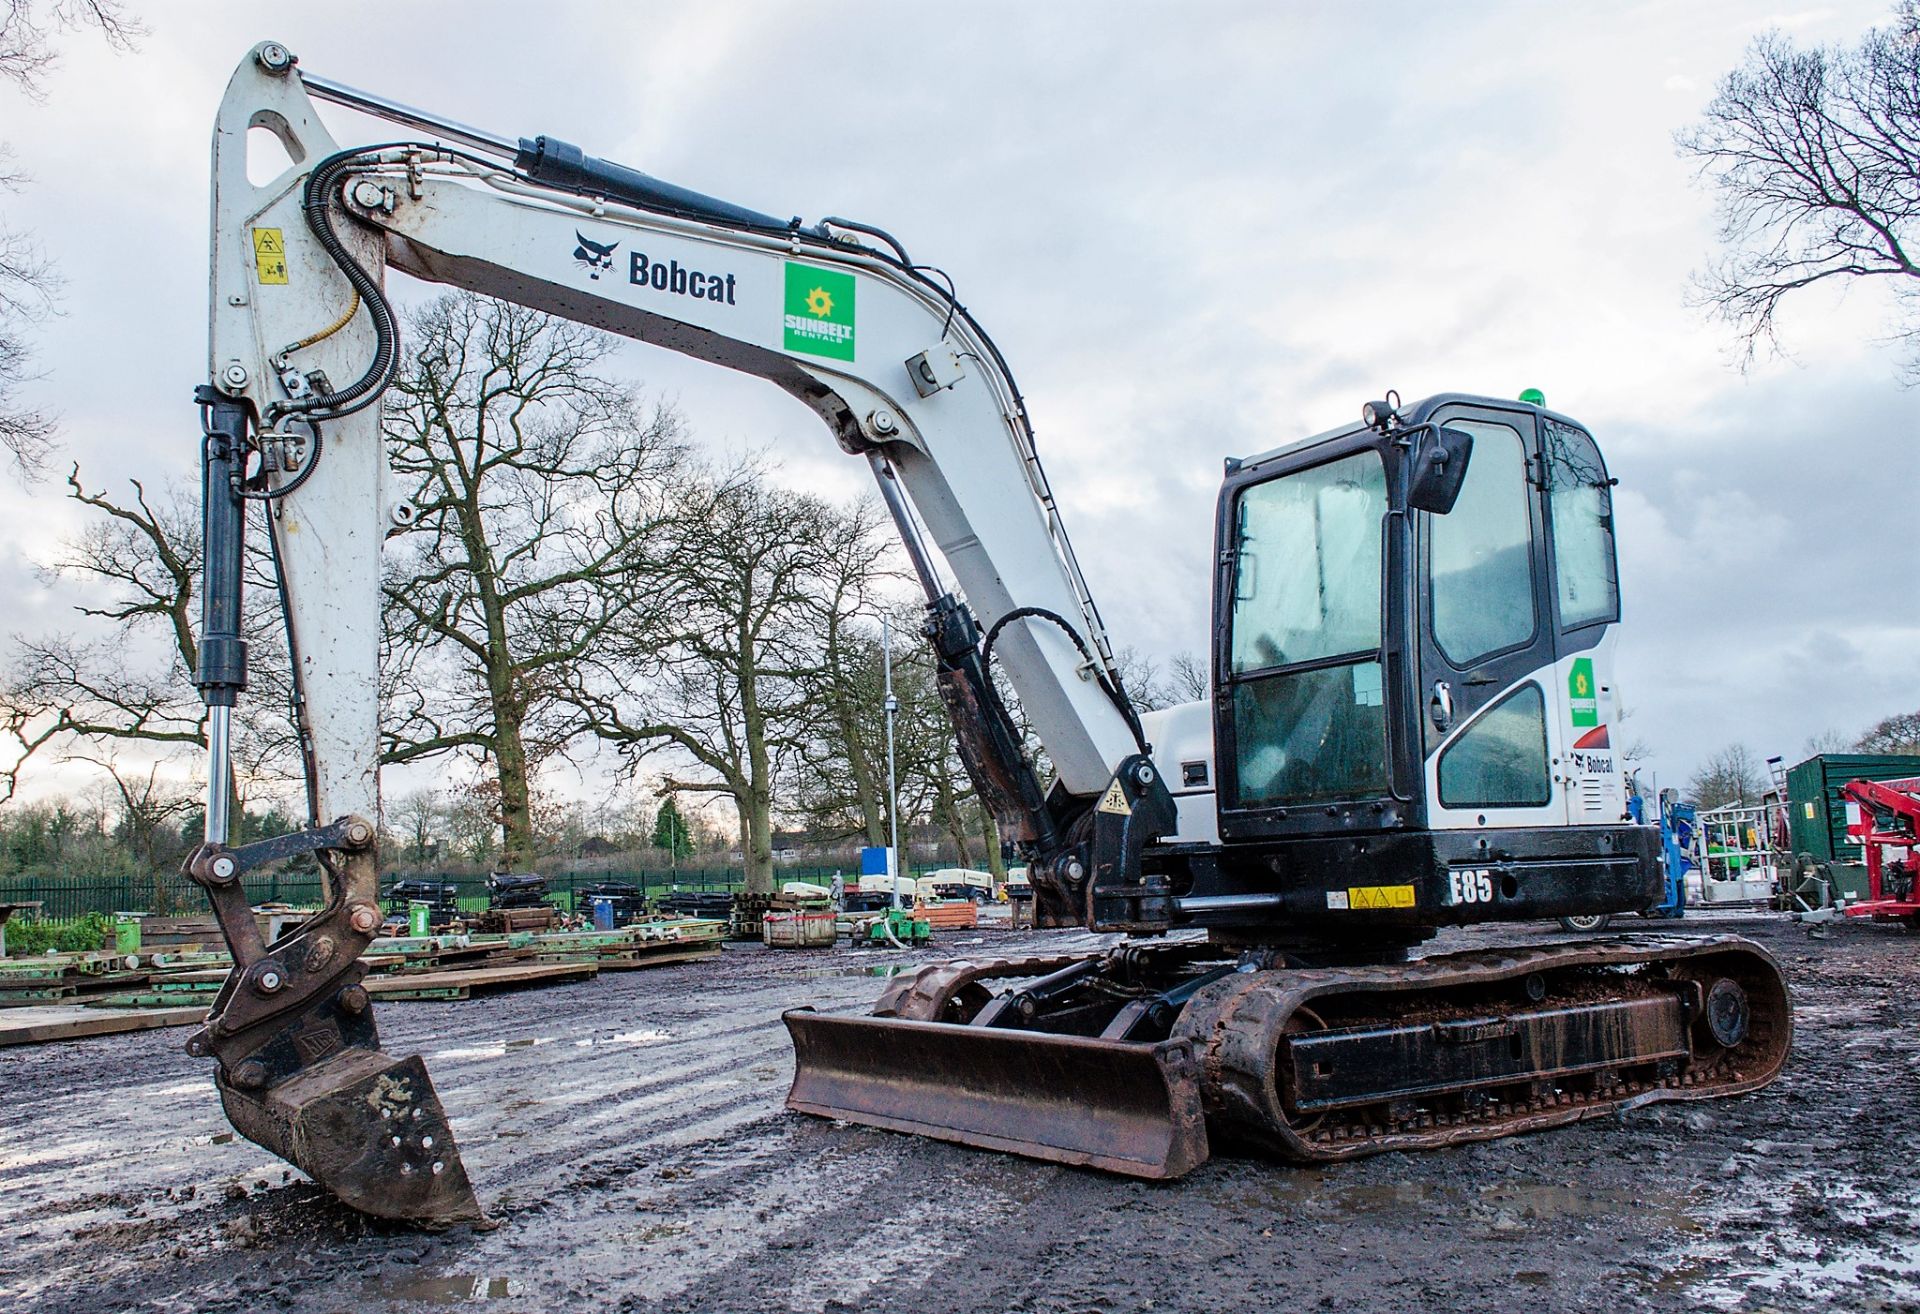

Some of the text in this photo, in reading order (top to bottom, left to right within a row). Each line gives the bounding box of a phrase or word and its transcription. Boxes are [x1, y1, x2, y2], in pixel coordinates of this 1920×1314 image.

[630, 251, 736, 306] Bobcat
[785, 314, 852, 339] SUNBELT
[1587, 755, 1613, 773] Bobcat
[1449, 870, 1492, 903] E85
